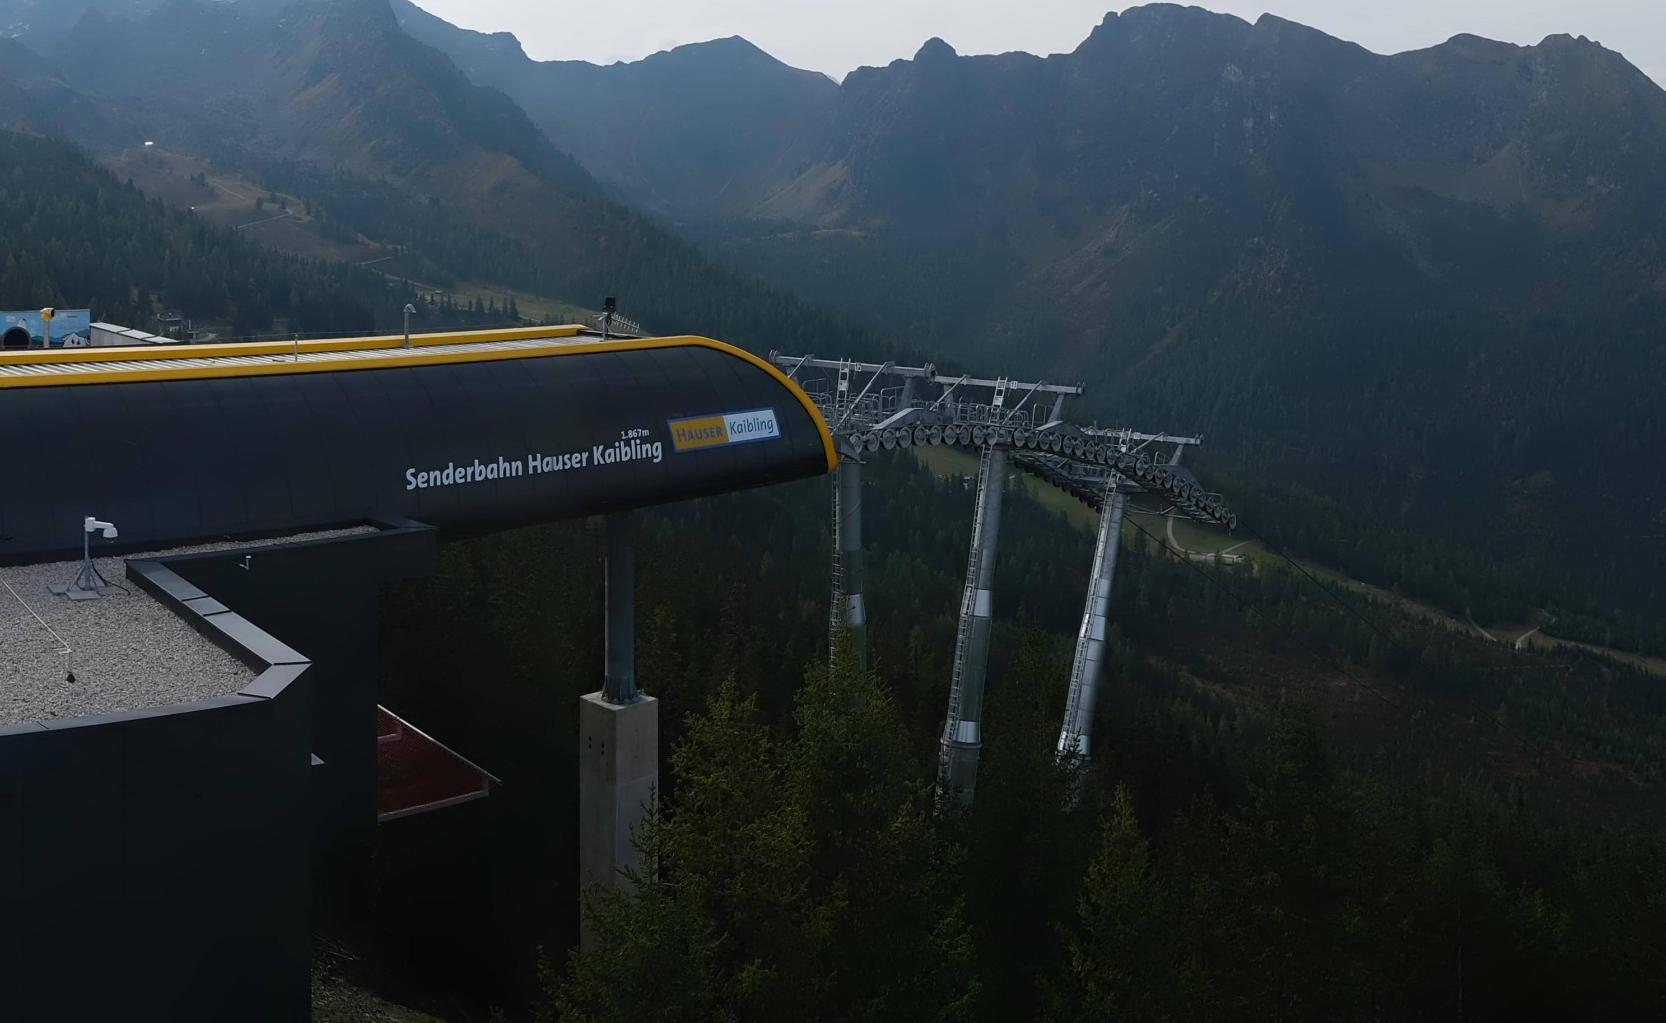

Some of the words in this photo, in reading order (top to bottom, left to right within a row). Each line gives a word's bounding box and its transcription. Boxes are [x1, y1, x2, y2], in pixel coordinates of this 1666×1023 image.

[621, 429, 650, 440] 1.867m
[676, 426, 724, 442] HAUSER
[729, 417, 774, 435] Kaibling
[406, 456, 522, 490] Senderbahn
[528, 449, 589, 474] Hauser
[593, 439, 663, 465] Kaibling
